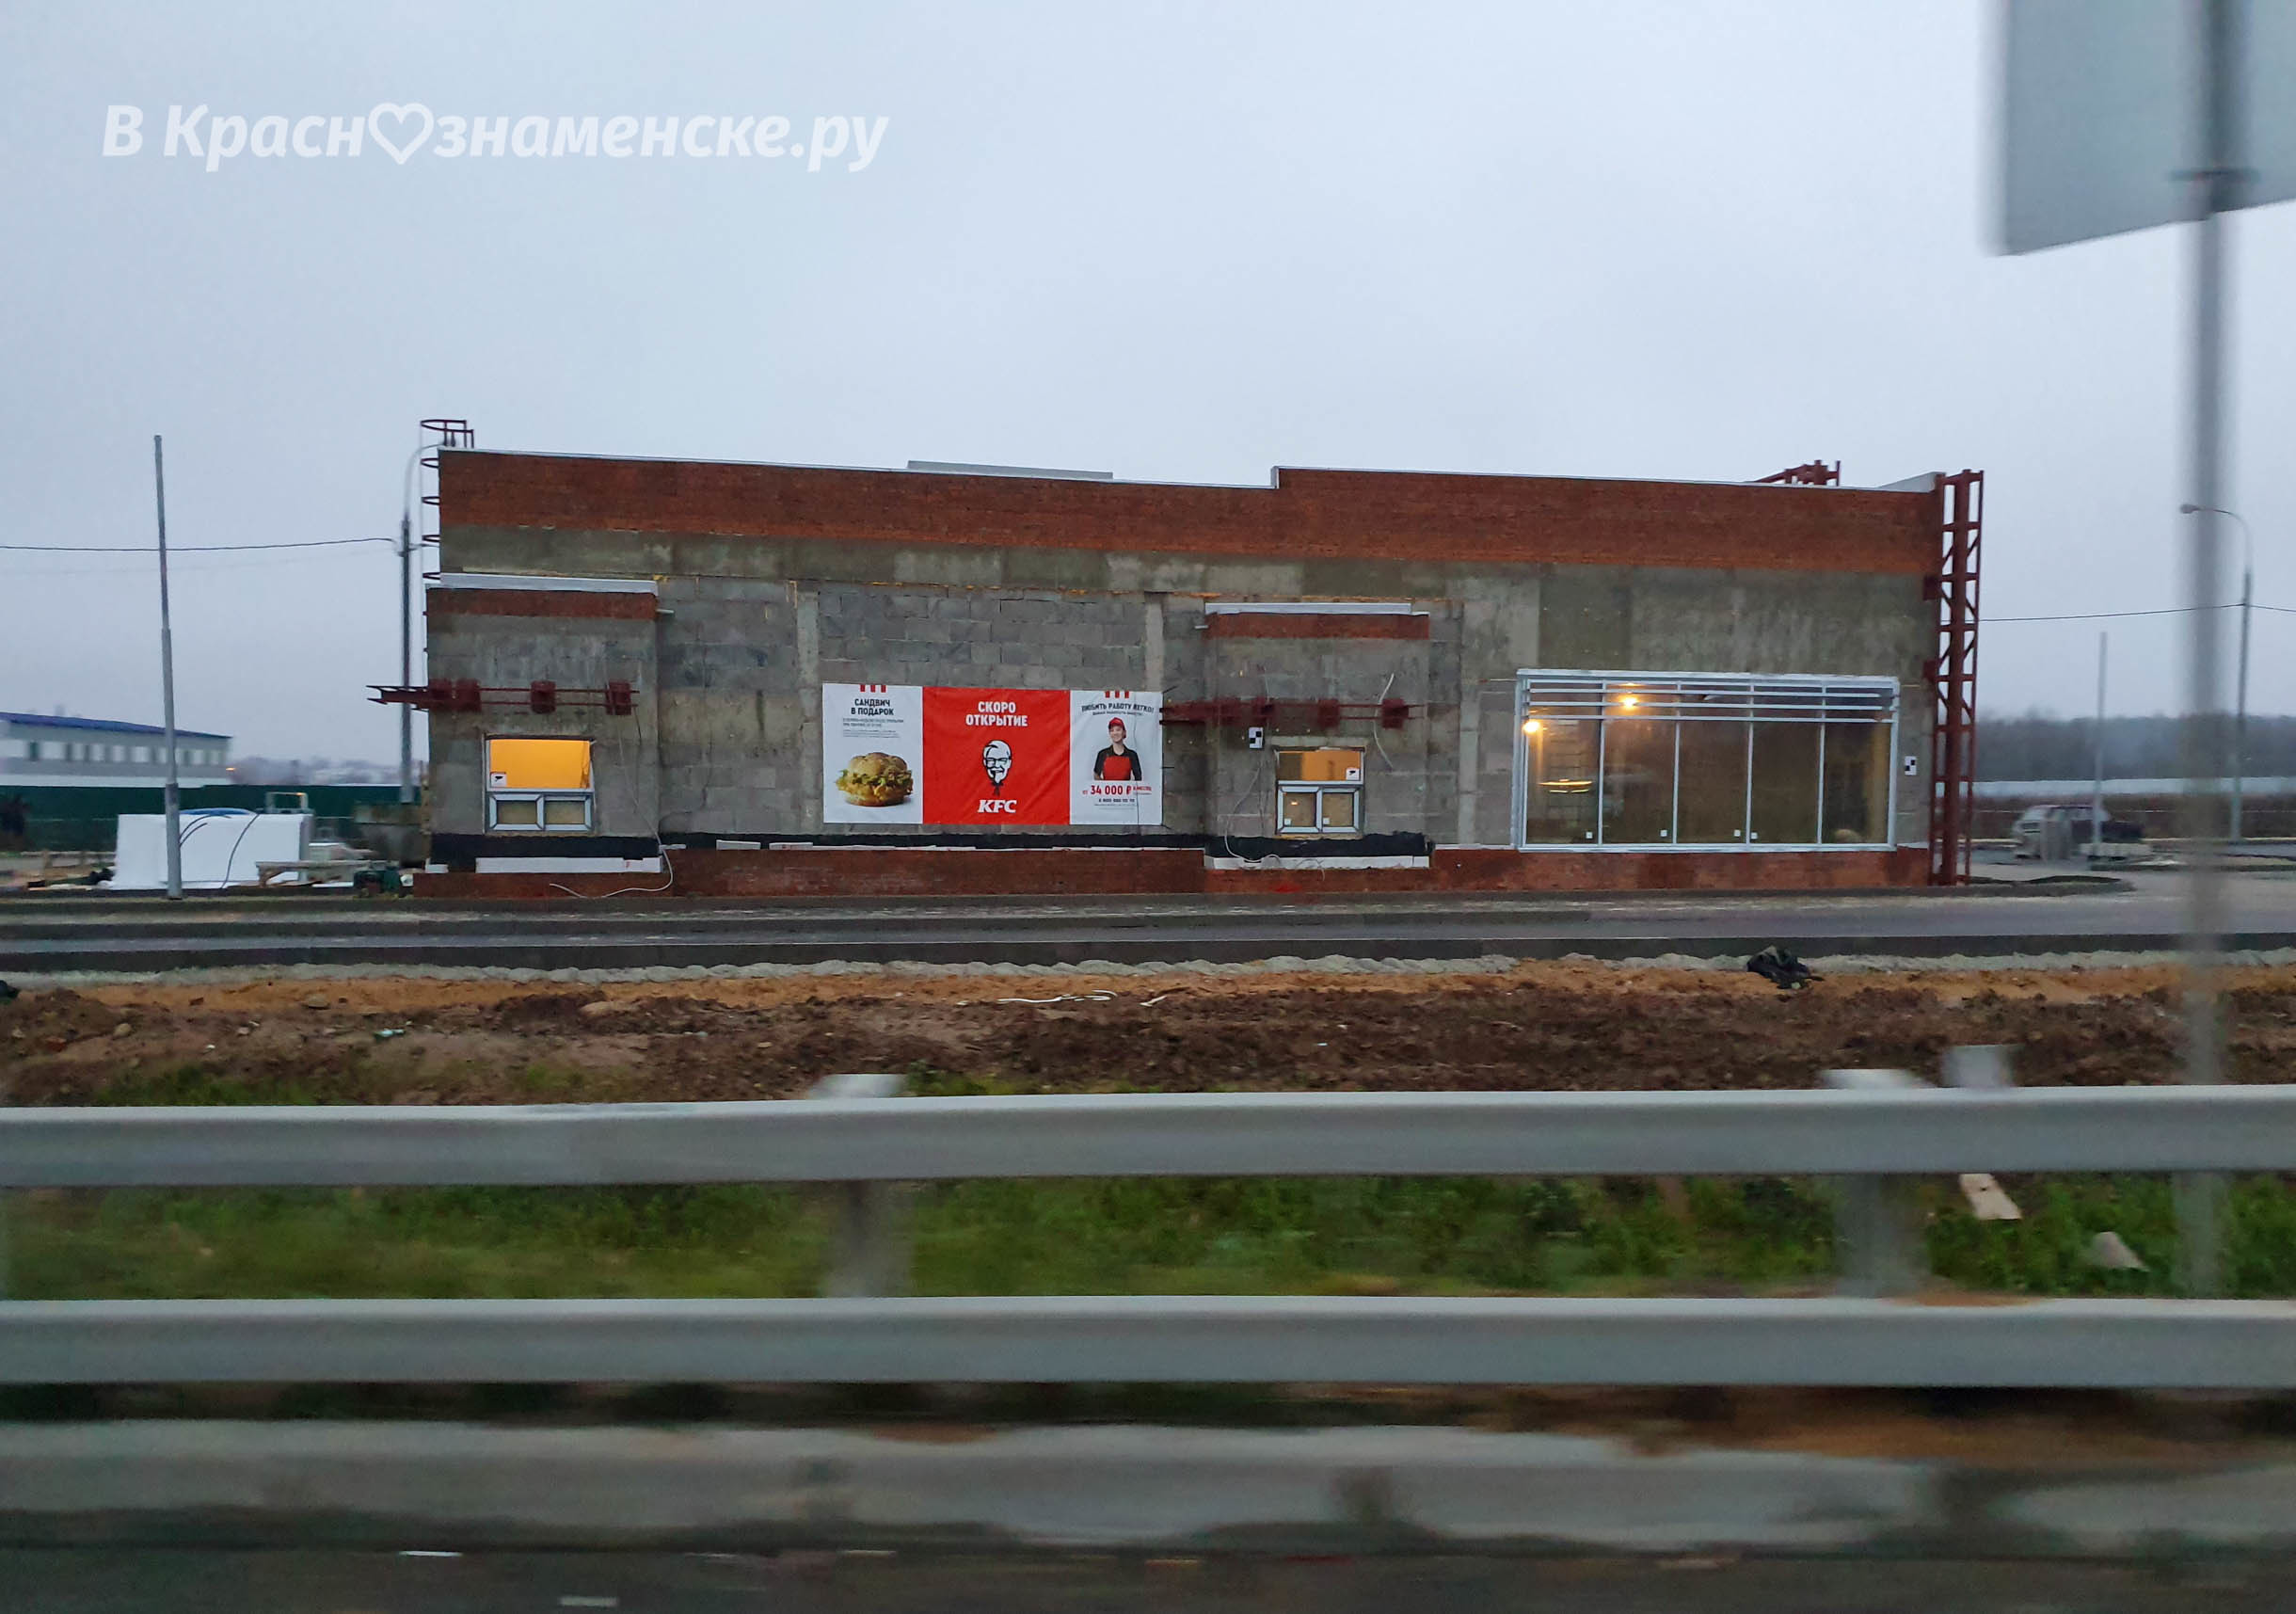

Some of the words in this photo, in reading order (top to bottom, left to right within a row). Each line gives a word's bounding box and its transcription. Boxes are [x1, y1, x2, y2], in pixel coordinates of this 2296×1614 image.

[854, 698, 890, 707] САНДВИЧ
[978, 701, 1016, 713] СКОРО
[1108, 702, 1132, 711] РАБОТУ
[857, 708, 894, 716] ПОДАРОК
[965, 714, 1028, 727] ОТКРЫТИЕ
[1091, 785, 1102, 795] 34
[1105, 785, 1124, 795] 000
[977, 799, 1017, 813] KFC
